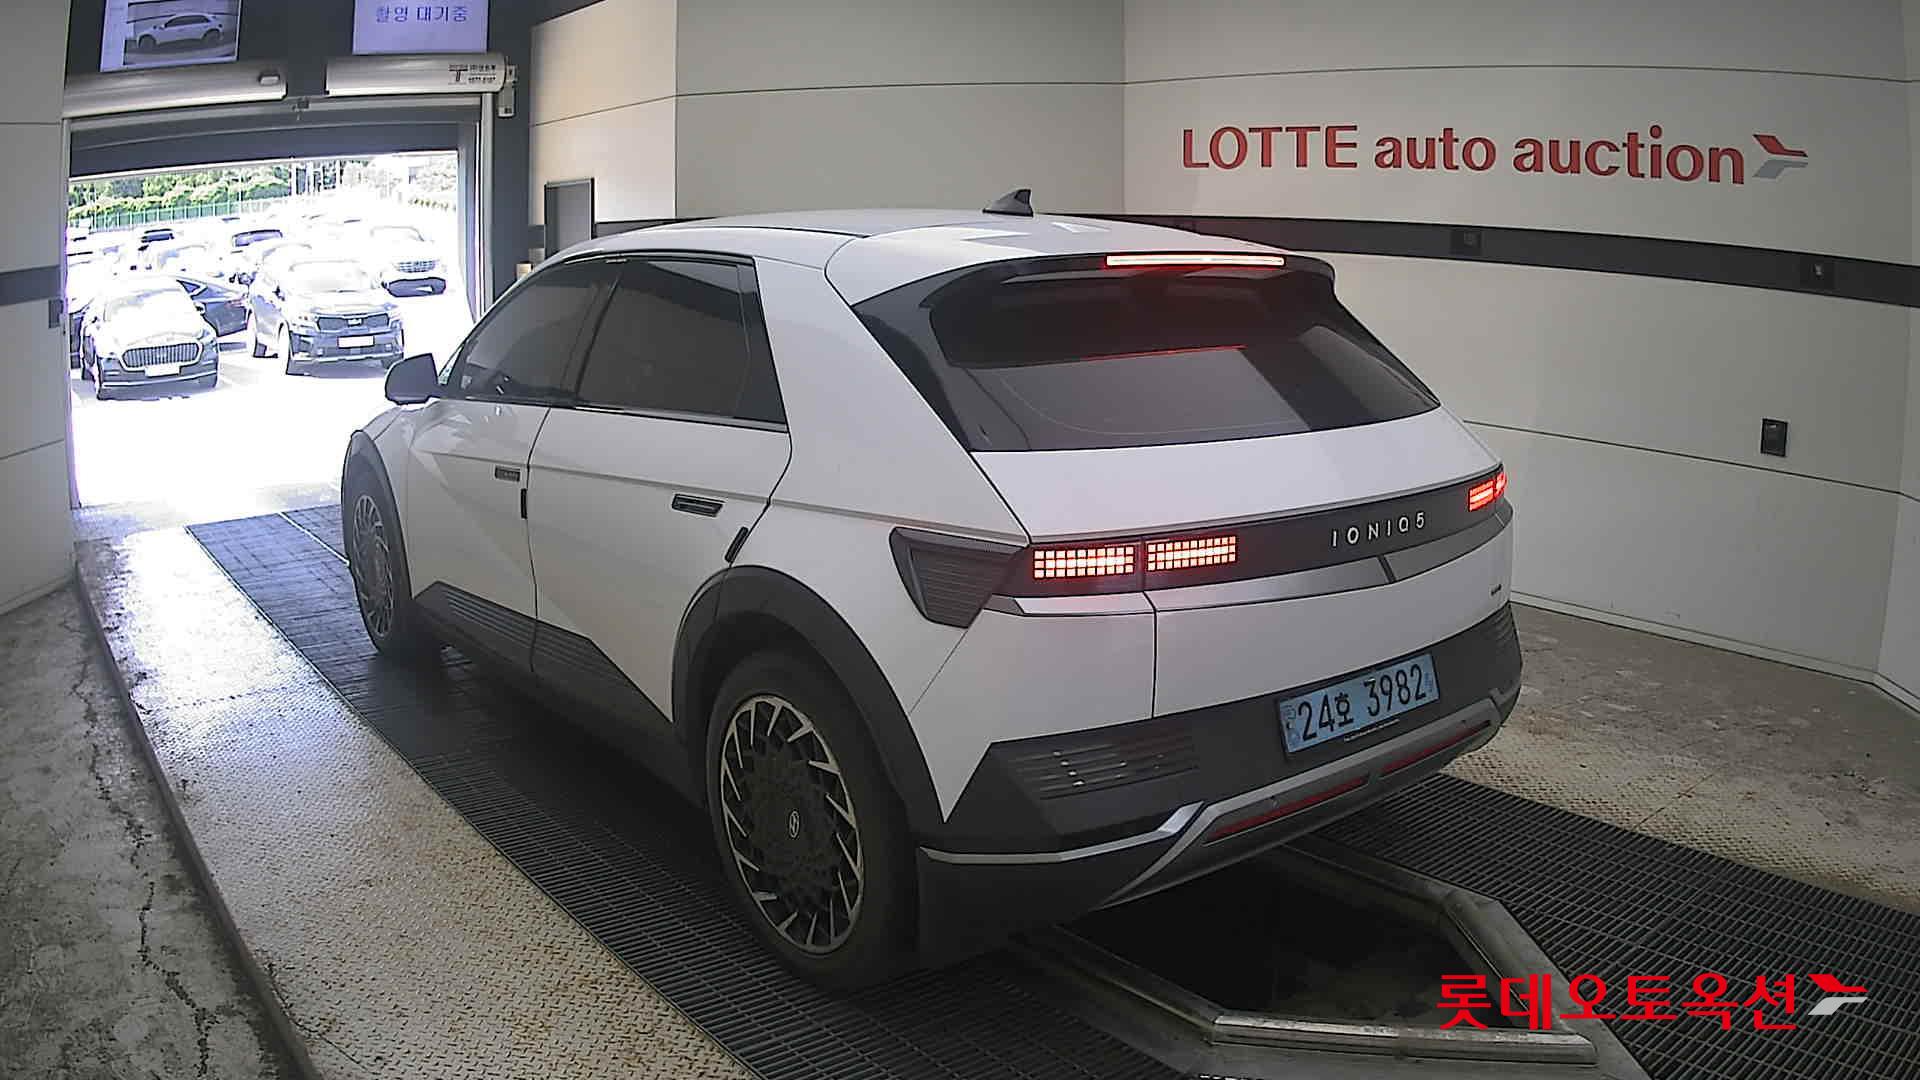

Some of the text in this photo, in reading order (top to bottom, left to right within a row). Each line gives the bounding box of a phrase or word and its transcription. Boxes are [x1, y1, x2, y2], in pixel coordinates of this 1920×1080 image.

[416, 5, 468, 23] 대기중
[1183, 124, 1745, 185] LOTTE auto auction
[1298, 692, 1354, 742] 24호
[1363, 663, 1427, 717] 3982
